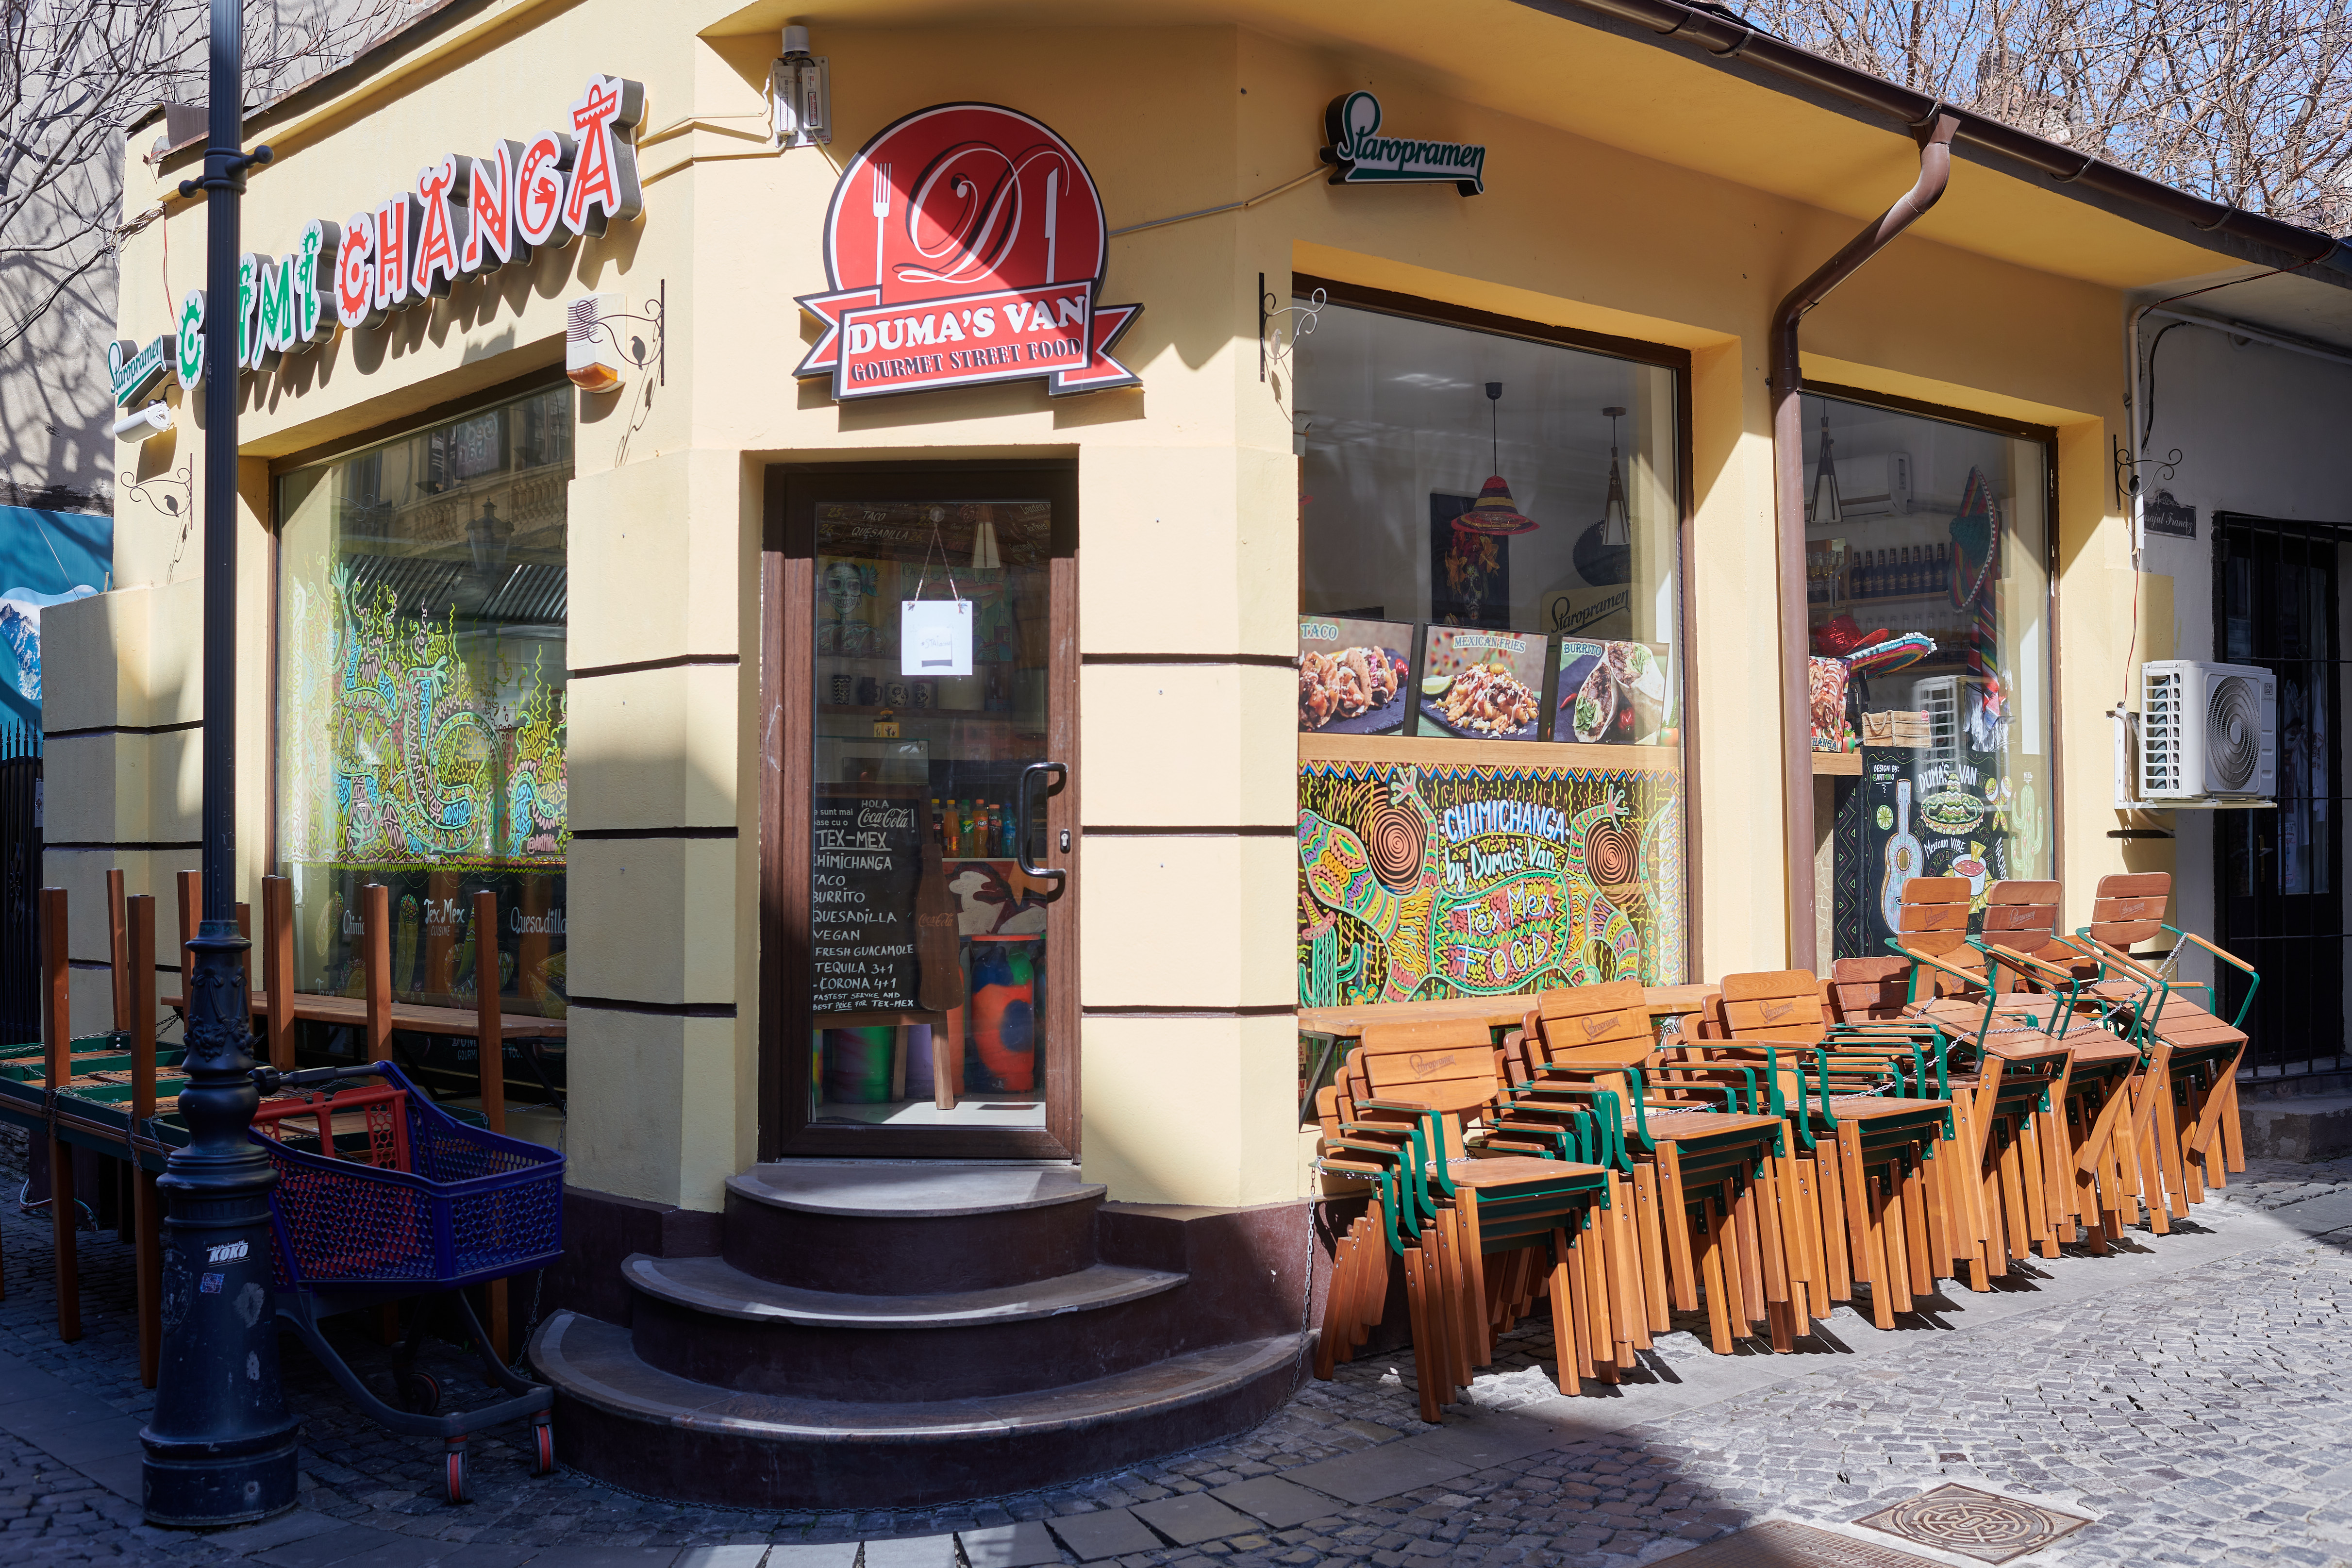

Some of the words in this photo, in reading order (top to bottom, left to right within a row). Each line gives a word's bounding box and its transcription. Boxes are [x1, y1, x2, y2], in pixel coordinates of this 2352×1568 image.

[1338, 92, 1485, 192] Staropramen
[849, 305, 995, 355] DUMA'S
[1003, 294, 1088, 334] VAN
[108, 336, 166, 394] Staropramen
[851, 353, 944, 382] GOURMET
[950, 343, 1021, 370] STREET
[1027, 337, 1082, 361] FOOD
[863, 511, 886, 521] TACO
[2144, 512, 2165, 529] asajul
[2165, 512, 2193, 534] Francez
[851, 526, 909, 541] QUESADILLA
[1551, 589, 1630, 634] Staropramen
[1300, 622, 1338, 641] TACO
[1453, 635, 1498, 649] MEXICAN
[1498, 637, 1526, 653] FRIES
[1563, 642, 1603, 657] BURRITO
[1874, 764, 1890, 772] DESIGN
[1918, 762, 1950, 793] DUMA'S
[1959, 764, 1977, 786] VAN
[839, 808, 853, 816] mai
[861, 799, 890, 809] HOLA
[1444, 800, 1565, 844] CHIMICHANGA
[816, 829, 888, 849] TEX-MEX
[1924, 838, 1949, 860] Mexican
[1950, 837, 1966, 853] VIBE
[1445, 847, 1466, 893] by
[1527, 837, 1556, 870] Van
[814, 887, 866, 903] BURRITO
[424, 898, 439, 924] Tex
[440, 897, 466, 924] Mex
[814, 908, 897, 924] QUESADILLA
[431, 924, 450, 937] CUISINE
[815, 947, 851, 957] FRESH
[853, 944, 914, 957] GUACAMOLE
[1457, 933, 1549, 980] FOOD
[814, 961, 866, 974] TEQUILA
[870, 963, 894, 974] 3+1
[873, 977, 897, 990] 4+1
[813, 993, 849, 1001] FASTEST
[835, 1000, 852, 1009] PRICE
[870, 999, 914, 1008] TEX-MEX
[1409, 1052, 1456, 1081] Staropramen
[209, 1244, 249, 1263] KOKO
